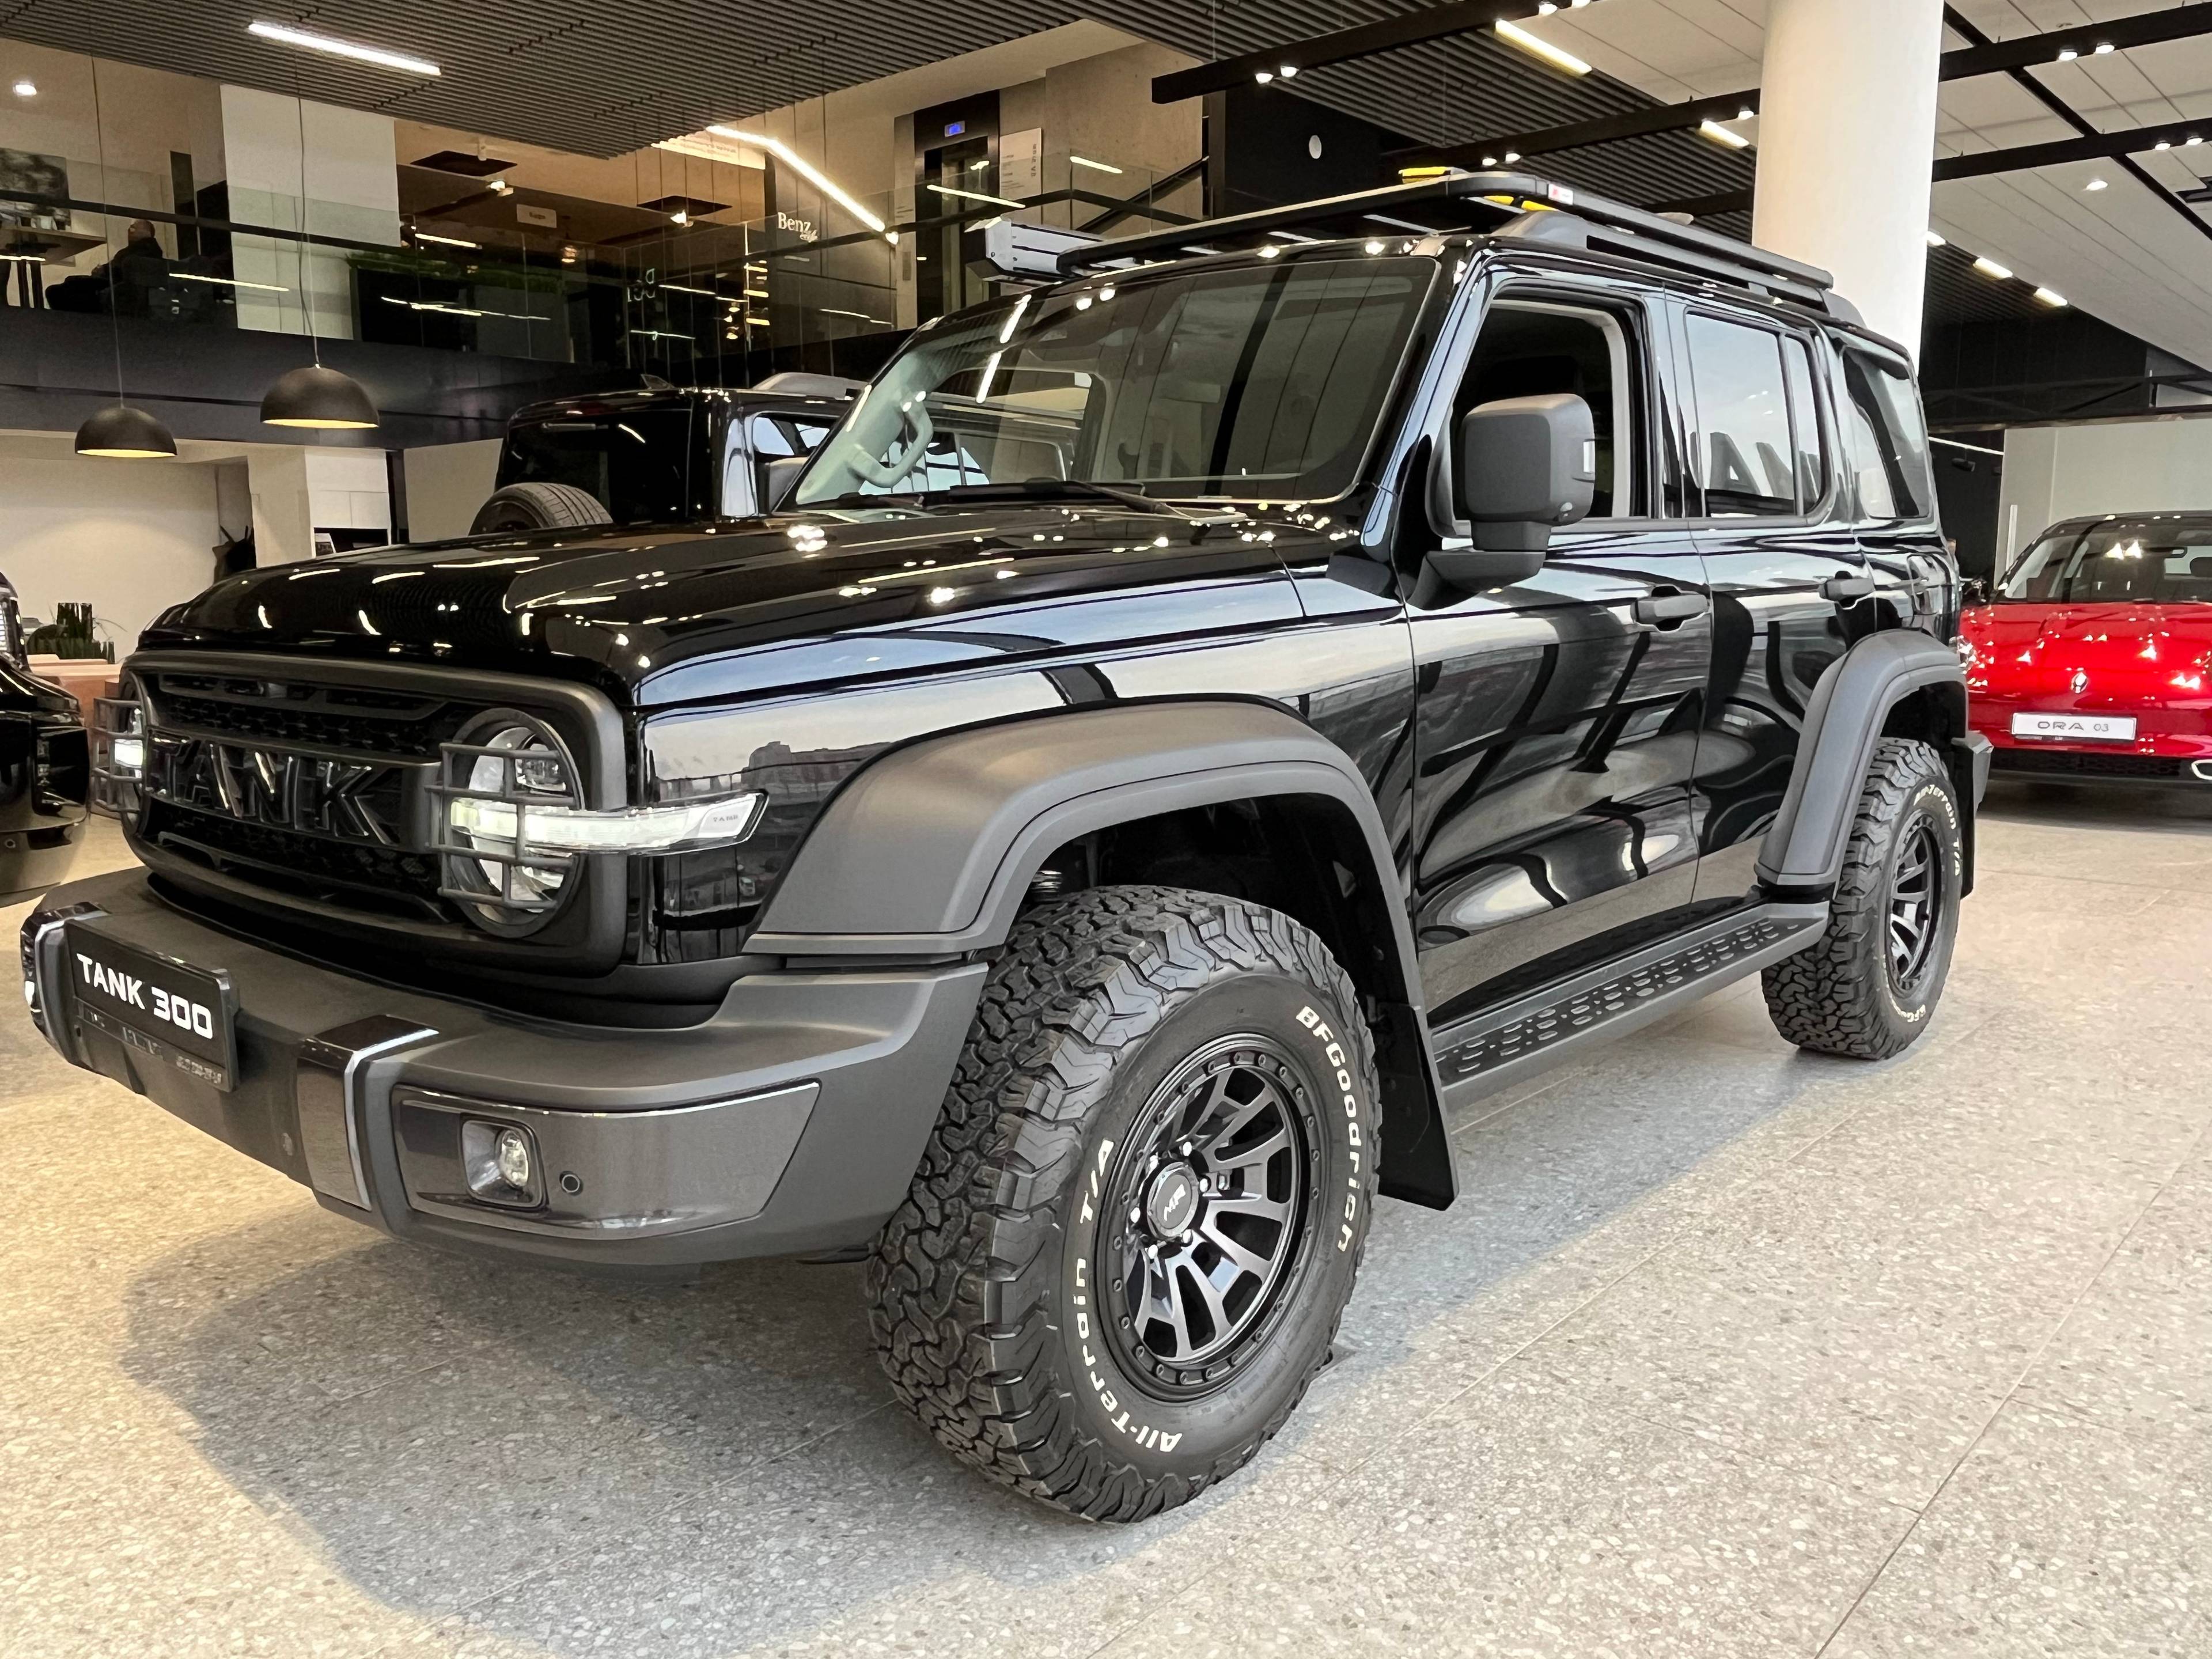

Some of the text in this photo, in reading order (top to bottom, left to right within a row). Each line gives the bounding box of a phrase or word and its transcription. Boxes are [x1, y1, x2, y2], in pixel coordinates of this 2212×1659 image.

[777, 211, 811, 233] Benz
[2037, 721, 2109, 732] ORA 03
[76, 953, 213, 1039] TANK 300
[1296, 1006, 1362, 1252] BFGoodrich
[1073, 1139, 1183, 1453] All-Terrain T/A
